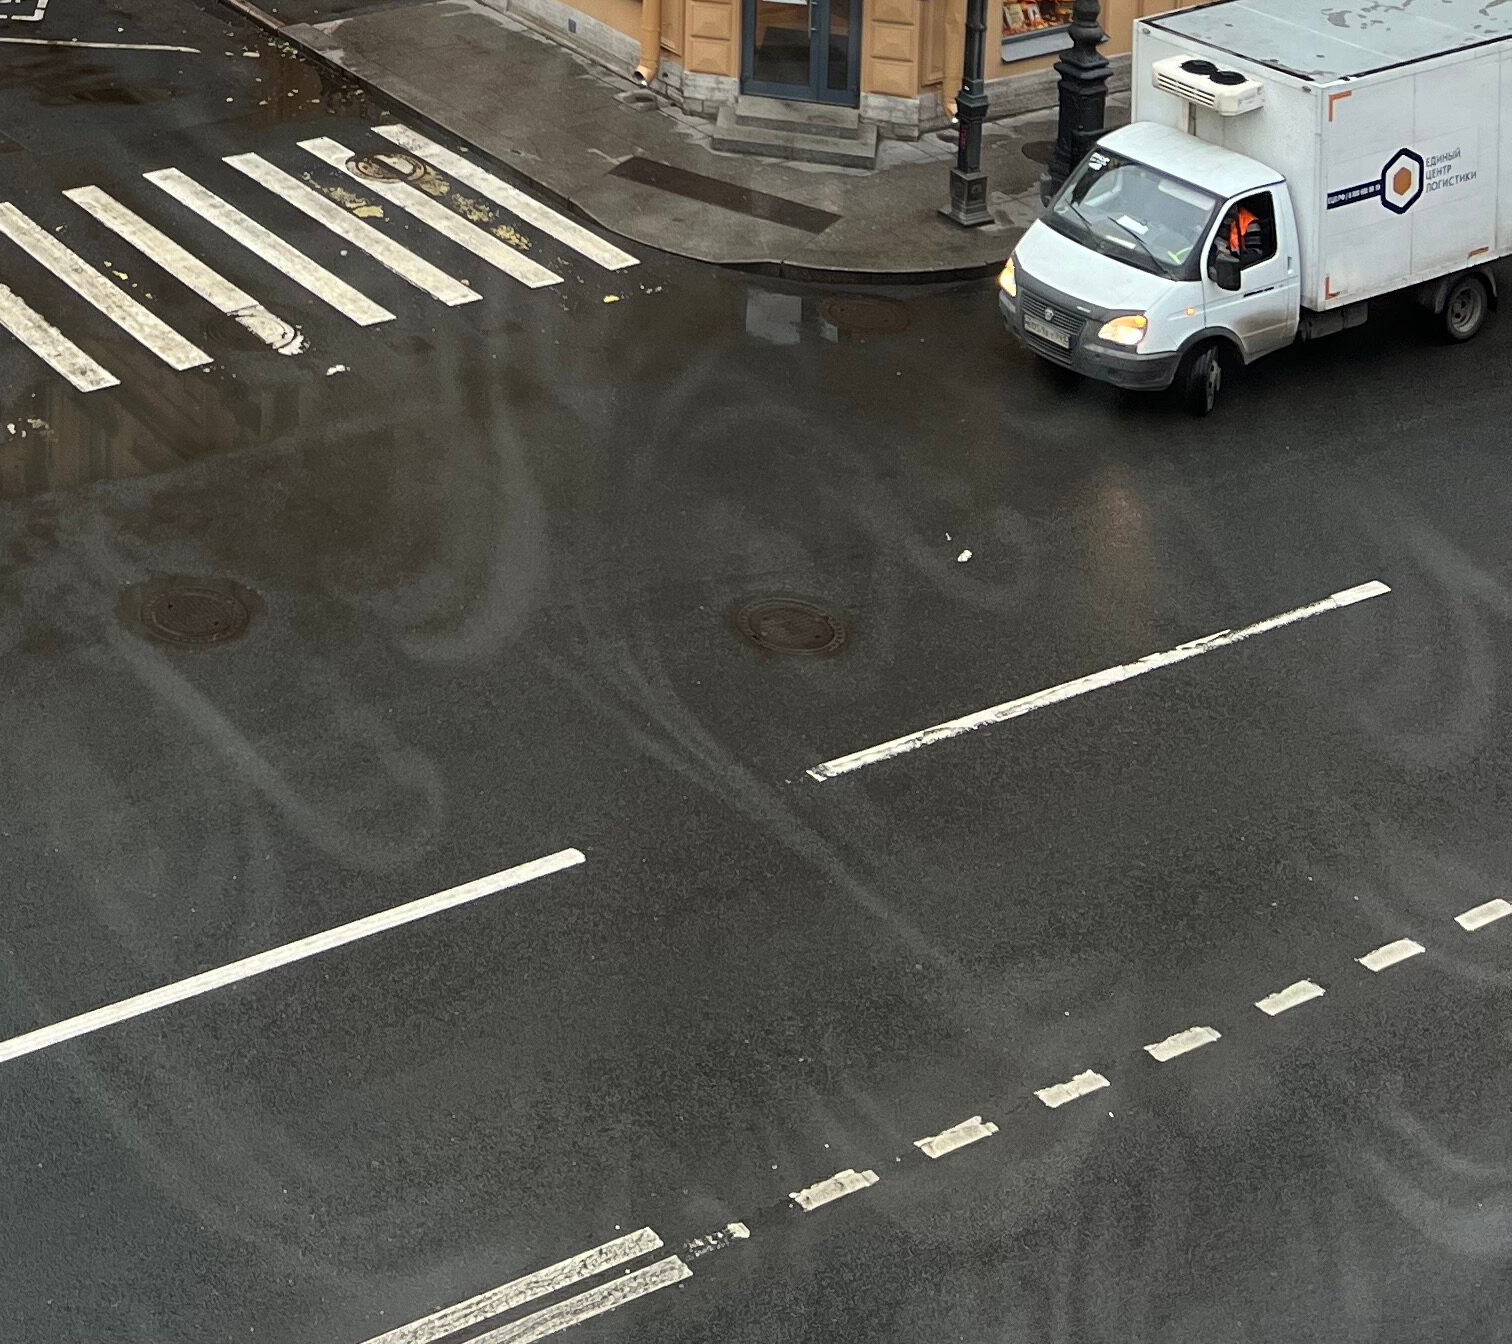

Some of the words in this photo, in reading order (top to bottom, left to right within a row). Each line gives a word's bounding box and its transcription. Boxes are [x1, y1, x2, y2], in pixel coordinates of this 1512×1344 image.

[1426, 147, 1461, 167] ЕДИНЫЙ
[1426, 164, 1452, 180] ЦЕНТР
[1426, 170, 1477, 193] ЛОГИСТИКИ
